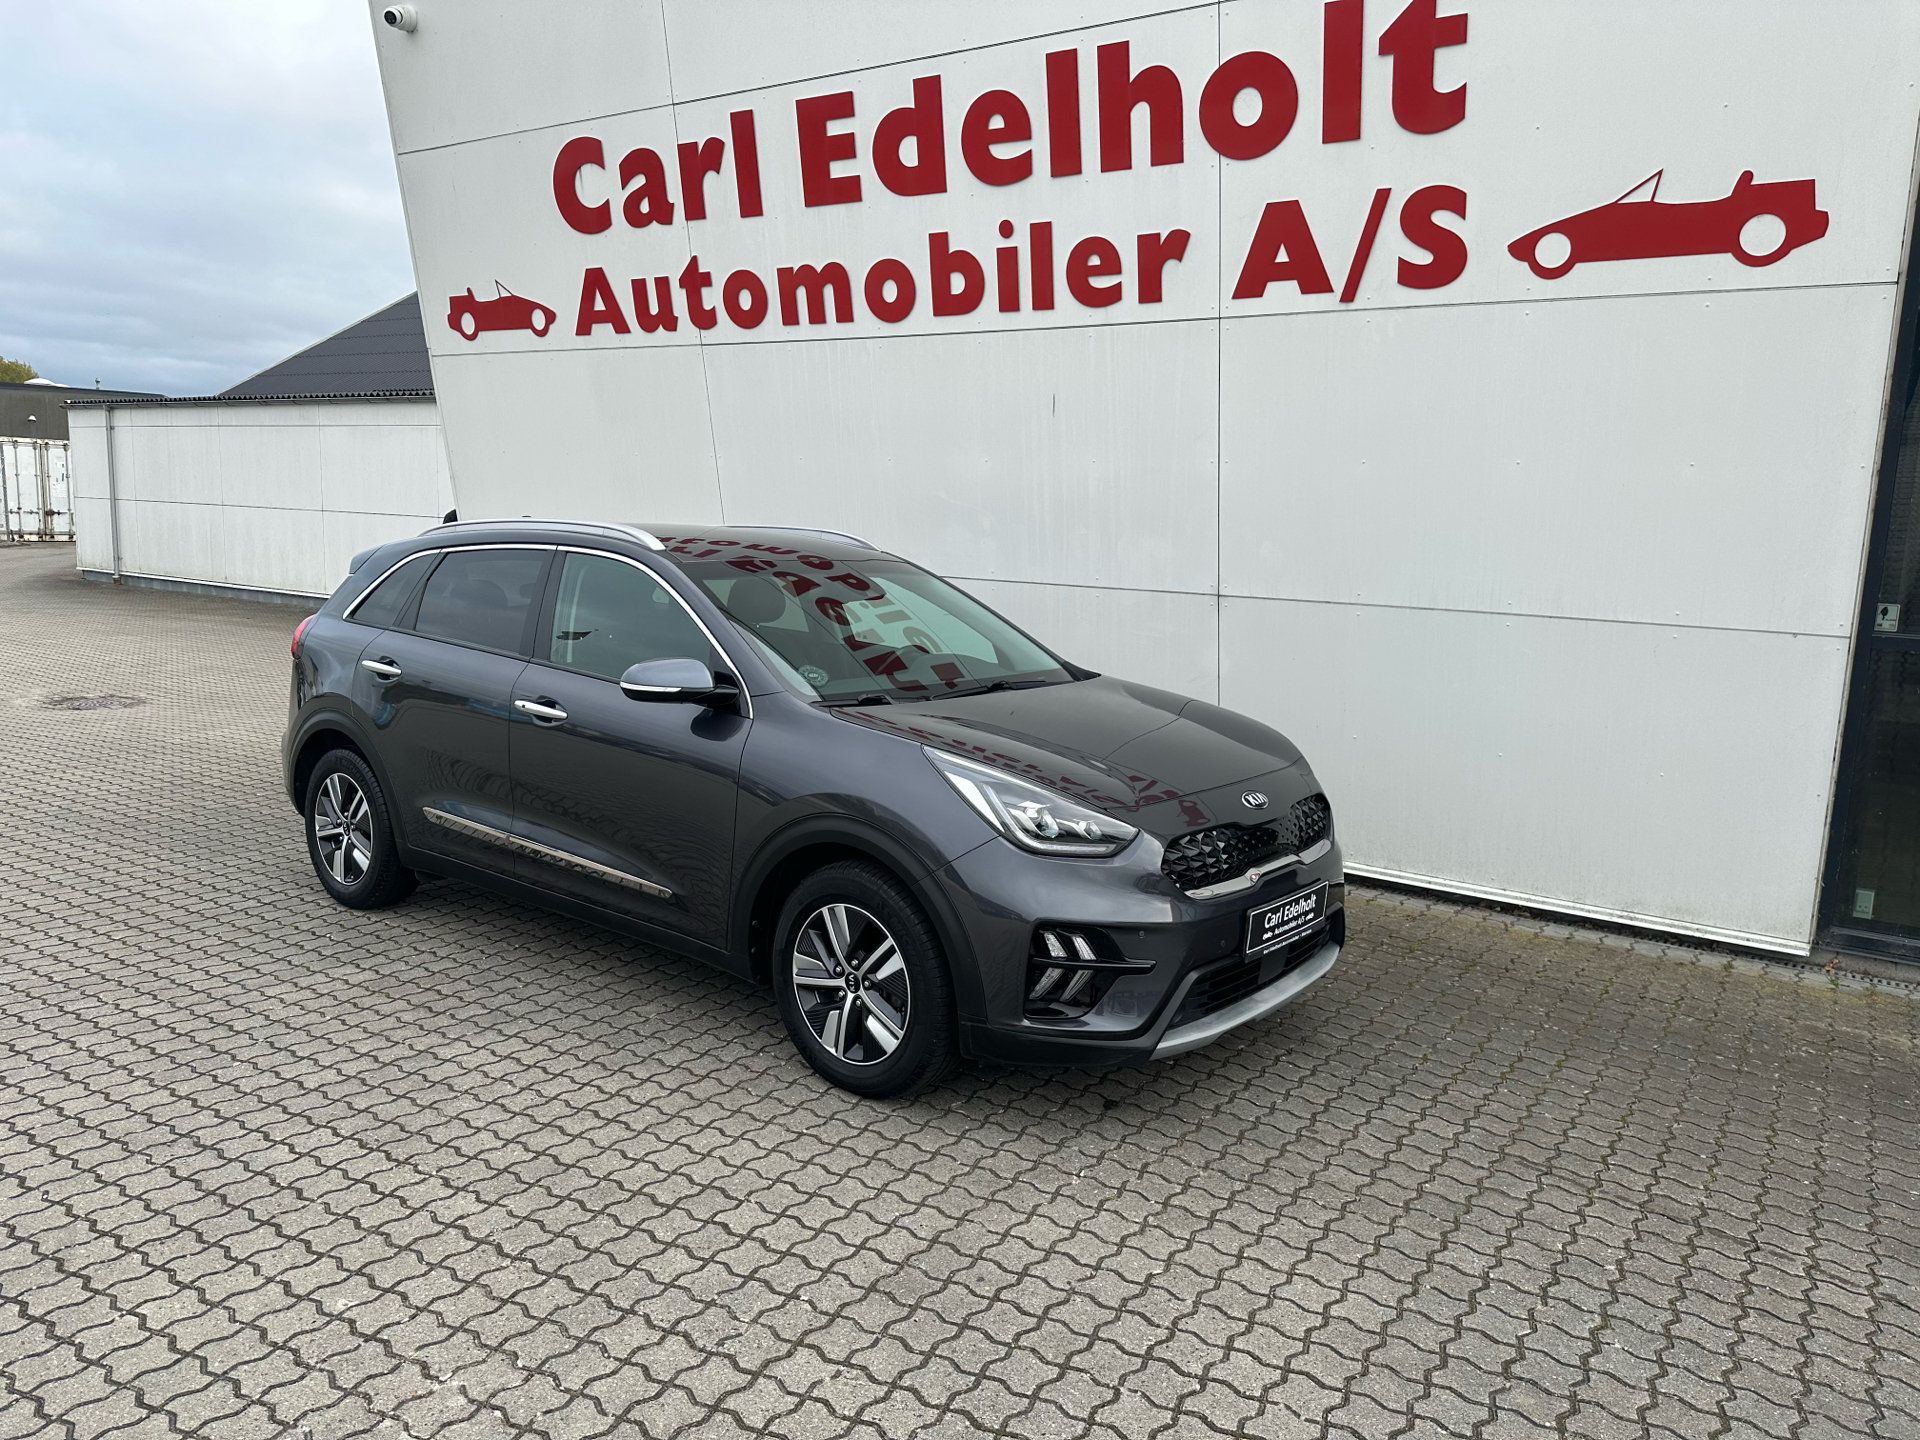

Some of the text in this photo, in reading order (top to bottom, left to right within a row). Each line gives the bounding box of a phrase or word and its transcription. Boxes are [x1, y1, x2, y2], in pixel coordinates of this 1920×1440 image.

[553, 0, 1468, 234] Carl Edelholt
[575, 185, 1468, 336] Automobiler A/S
[1264, 893, 1317, 929] Carl Edelholt
